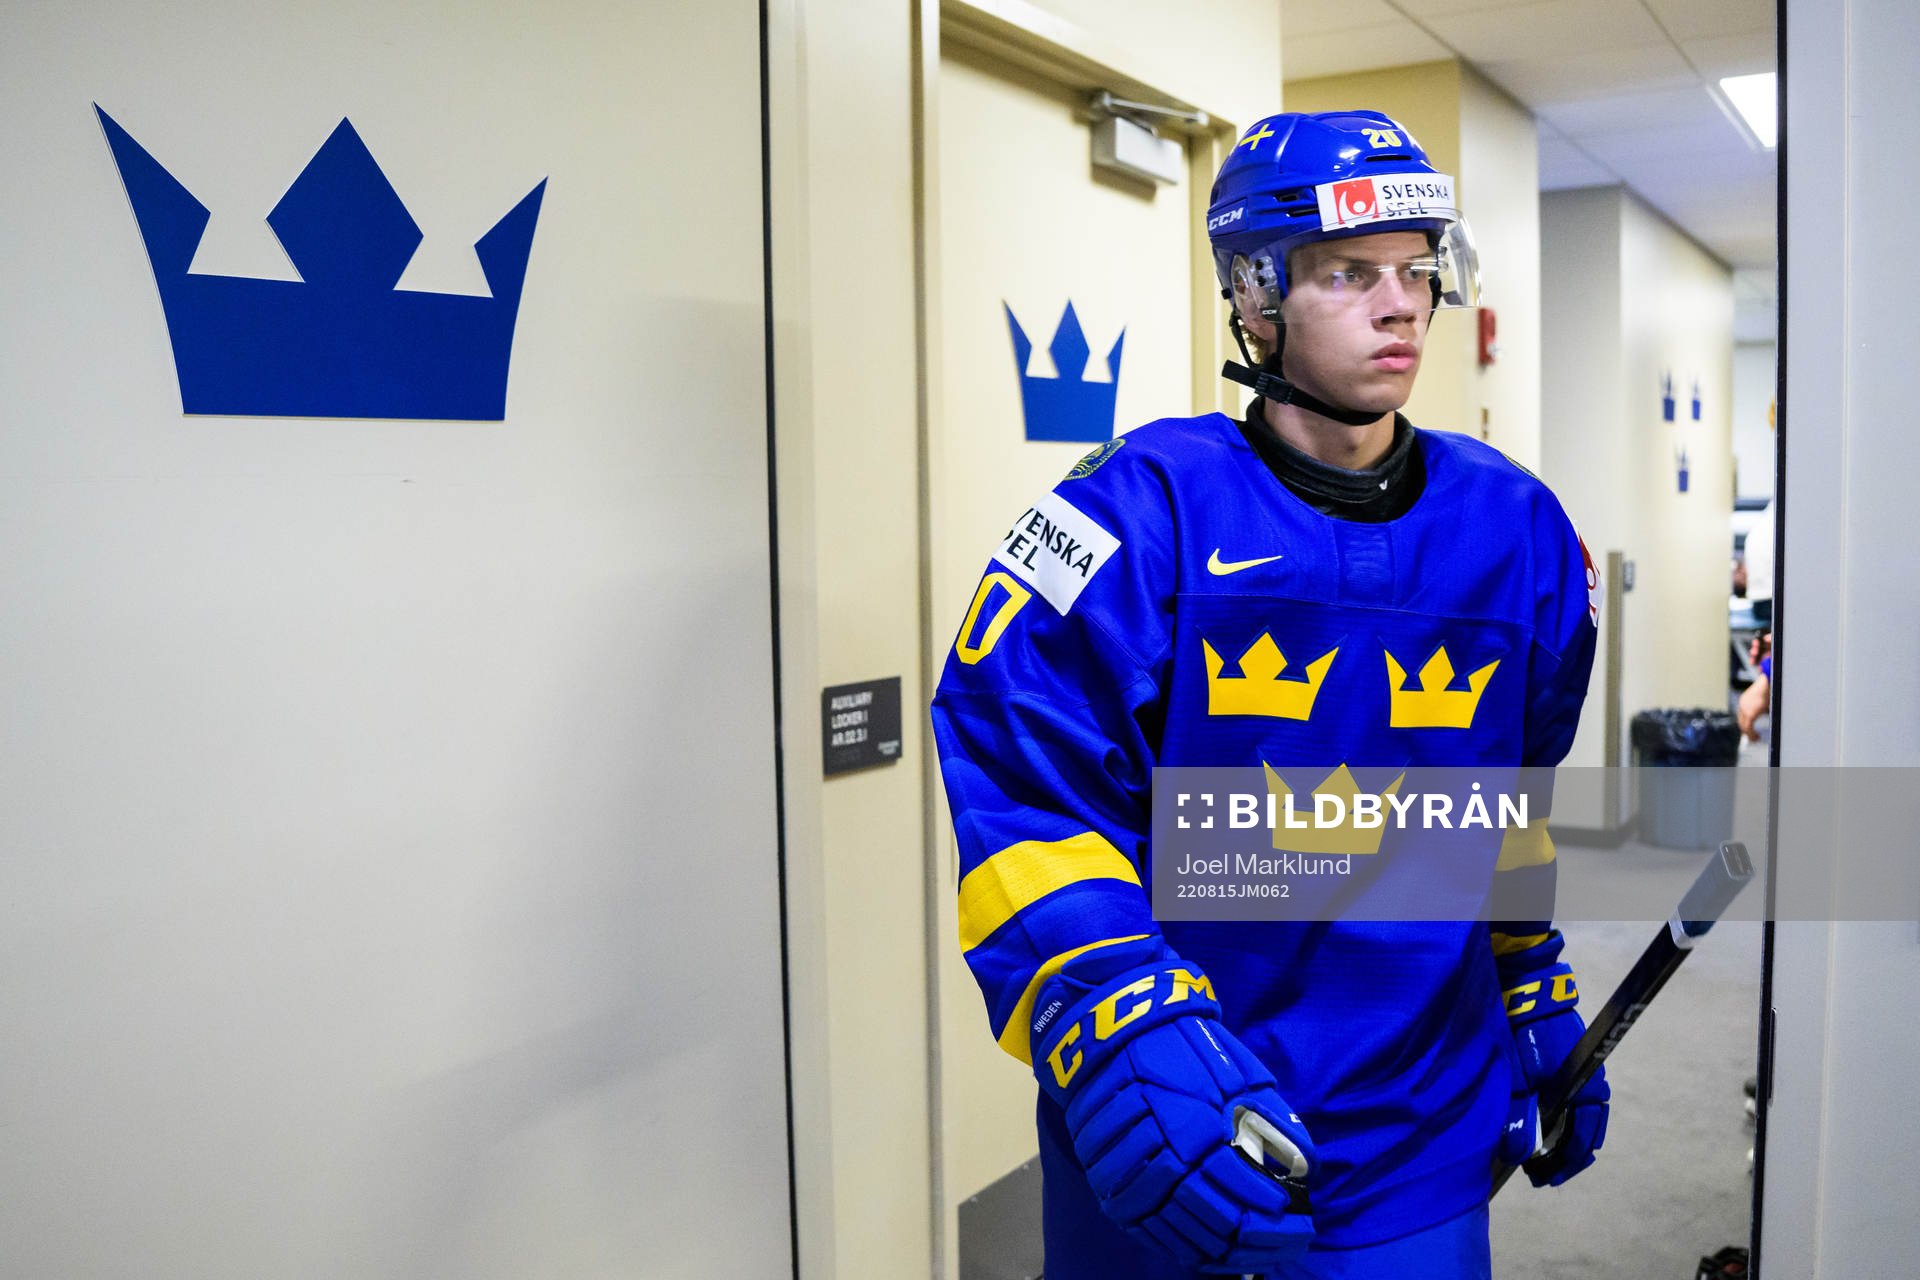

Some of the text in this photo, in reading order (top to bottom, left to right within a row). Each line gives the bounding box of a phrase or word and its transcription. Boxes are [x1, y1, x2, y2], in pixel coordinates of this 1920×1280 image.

[1208, 207, 1244, 231] CCM
[1003, 529, 1039, 572] EL
[1033, 1000, 1063, 1033] SWEDEN
[1046, 968, 1217, 1089] CCM
